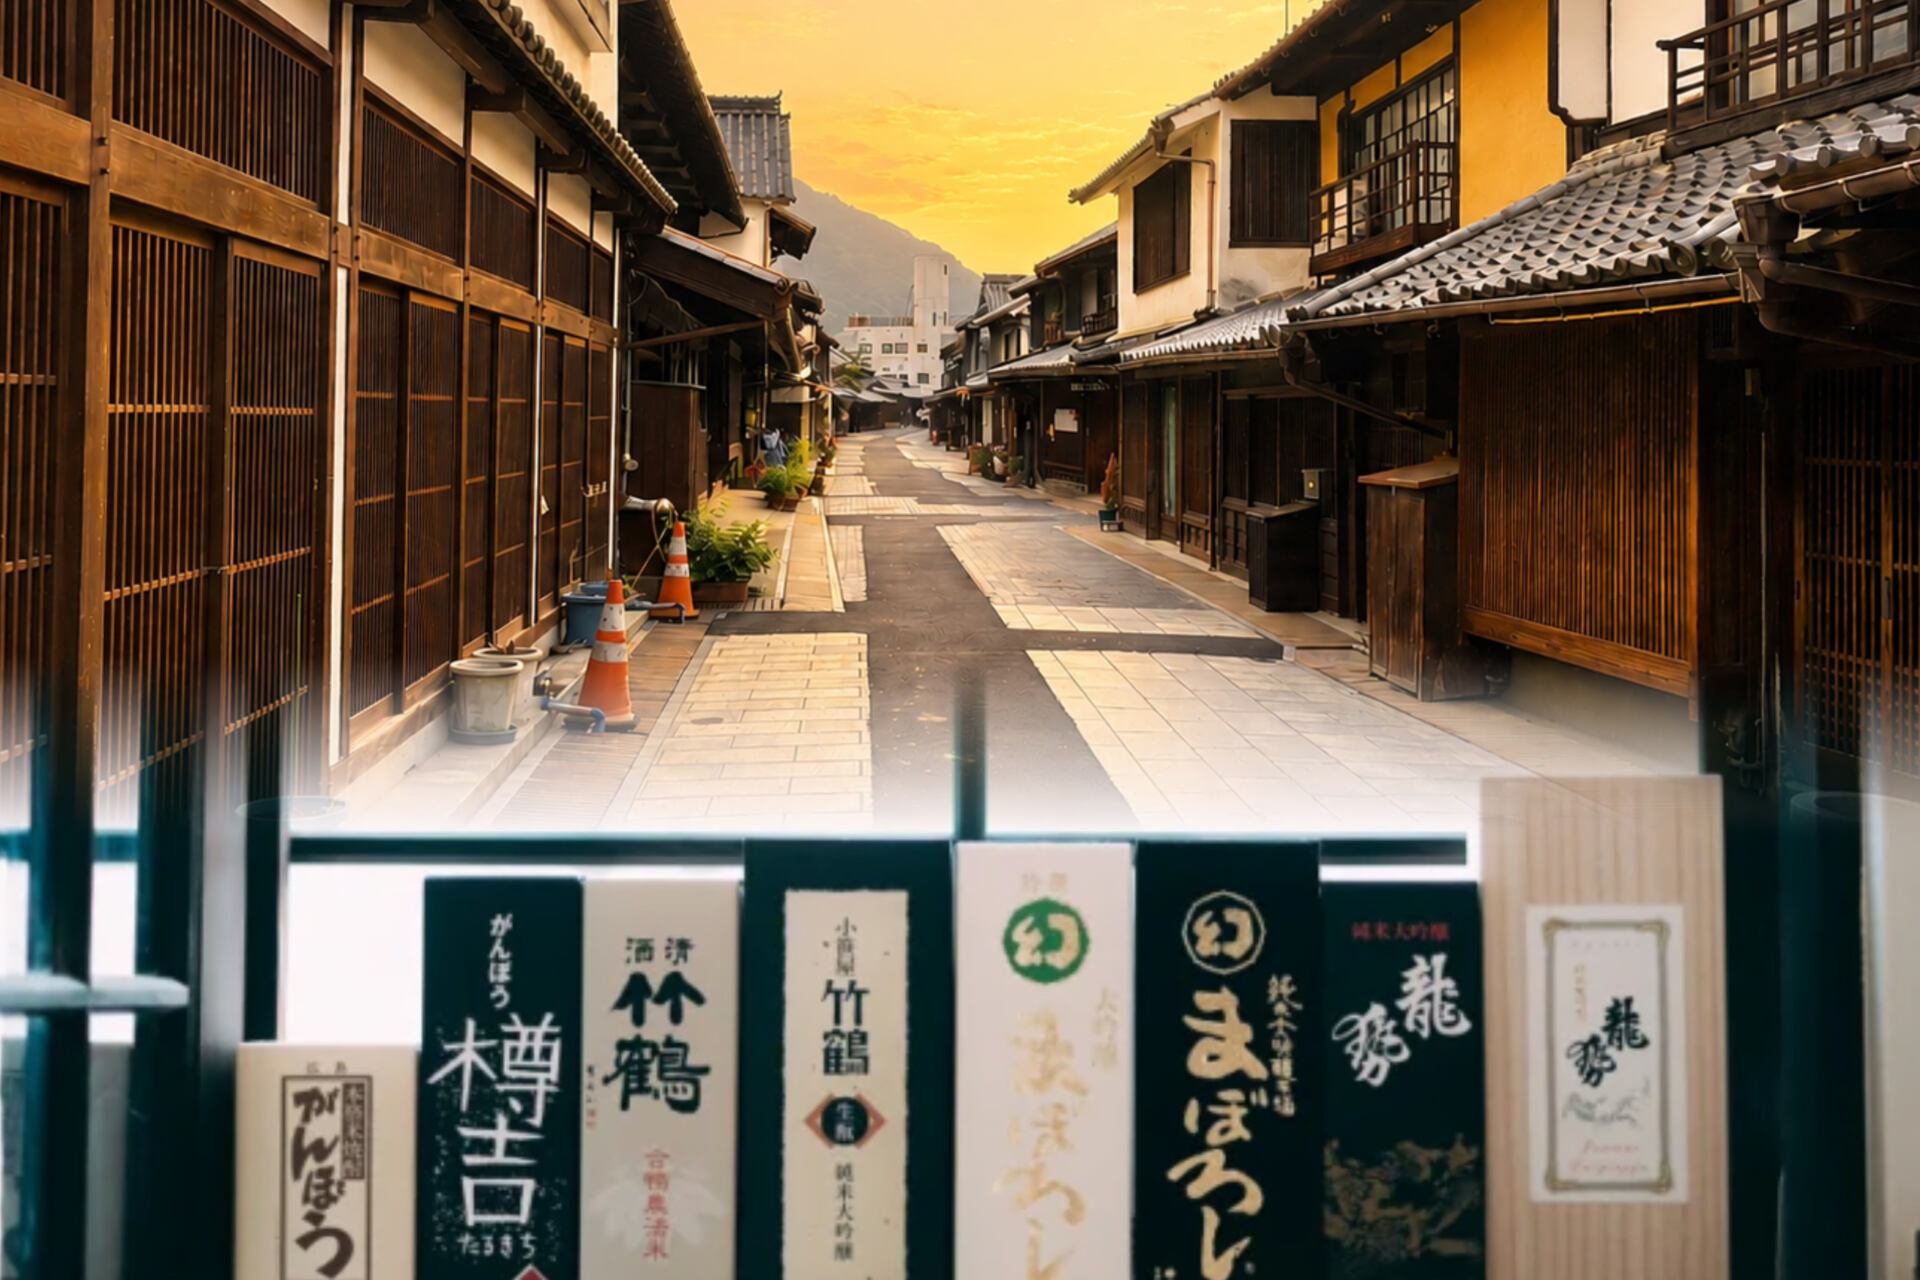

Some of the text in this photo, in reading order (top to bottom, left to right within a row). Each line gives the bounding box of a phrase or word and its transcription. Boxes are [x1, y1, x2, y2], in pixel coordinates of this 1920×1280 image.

[1192, 907, 1254, 959] 幻
[602, 971, 711, 1114] 竹鶴
[820, 979, 870, 1076] 竹鶴
